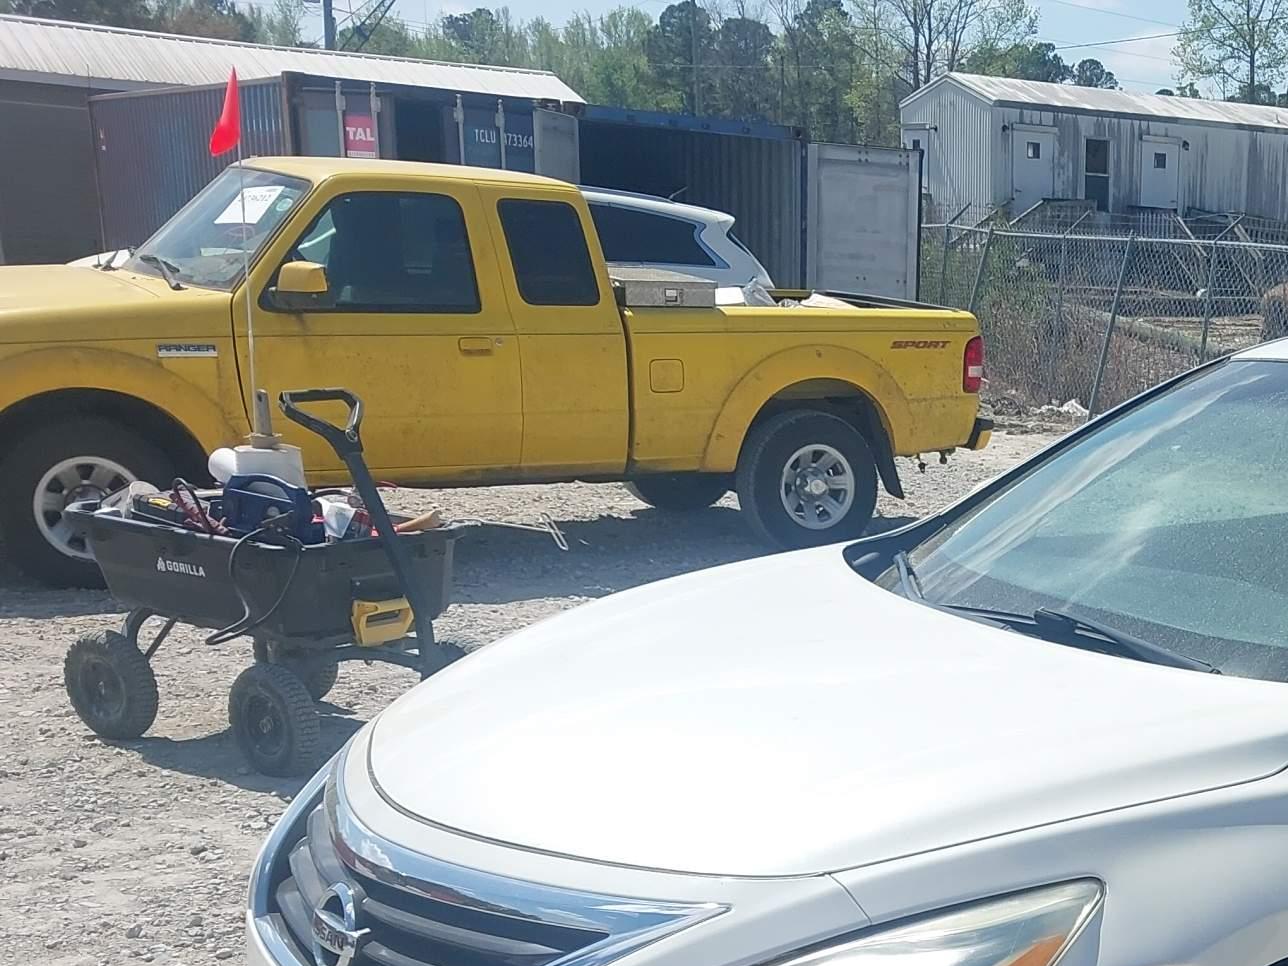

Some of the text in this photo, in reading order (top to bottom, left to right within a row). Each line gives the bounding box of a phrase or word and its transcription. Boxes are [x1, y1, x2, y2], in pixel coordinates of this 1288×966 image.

[345, 127, 376, 141] TAL
[475, 129, 496, 144] TCLU
[890, 340, 953, 350] SPORT
[166, 560, 206, 577] GORILLA
